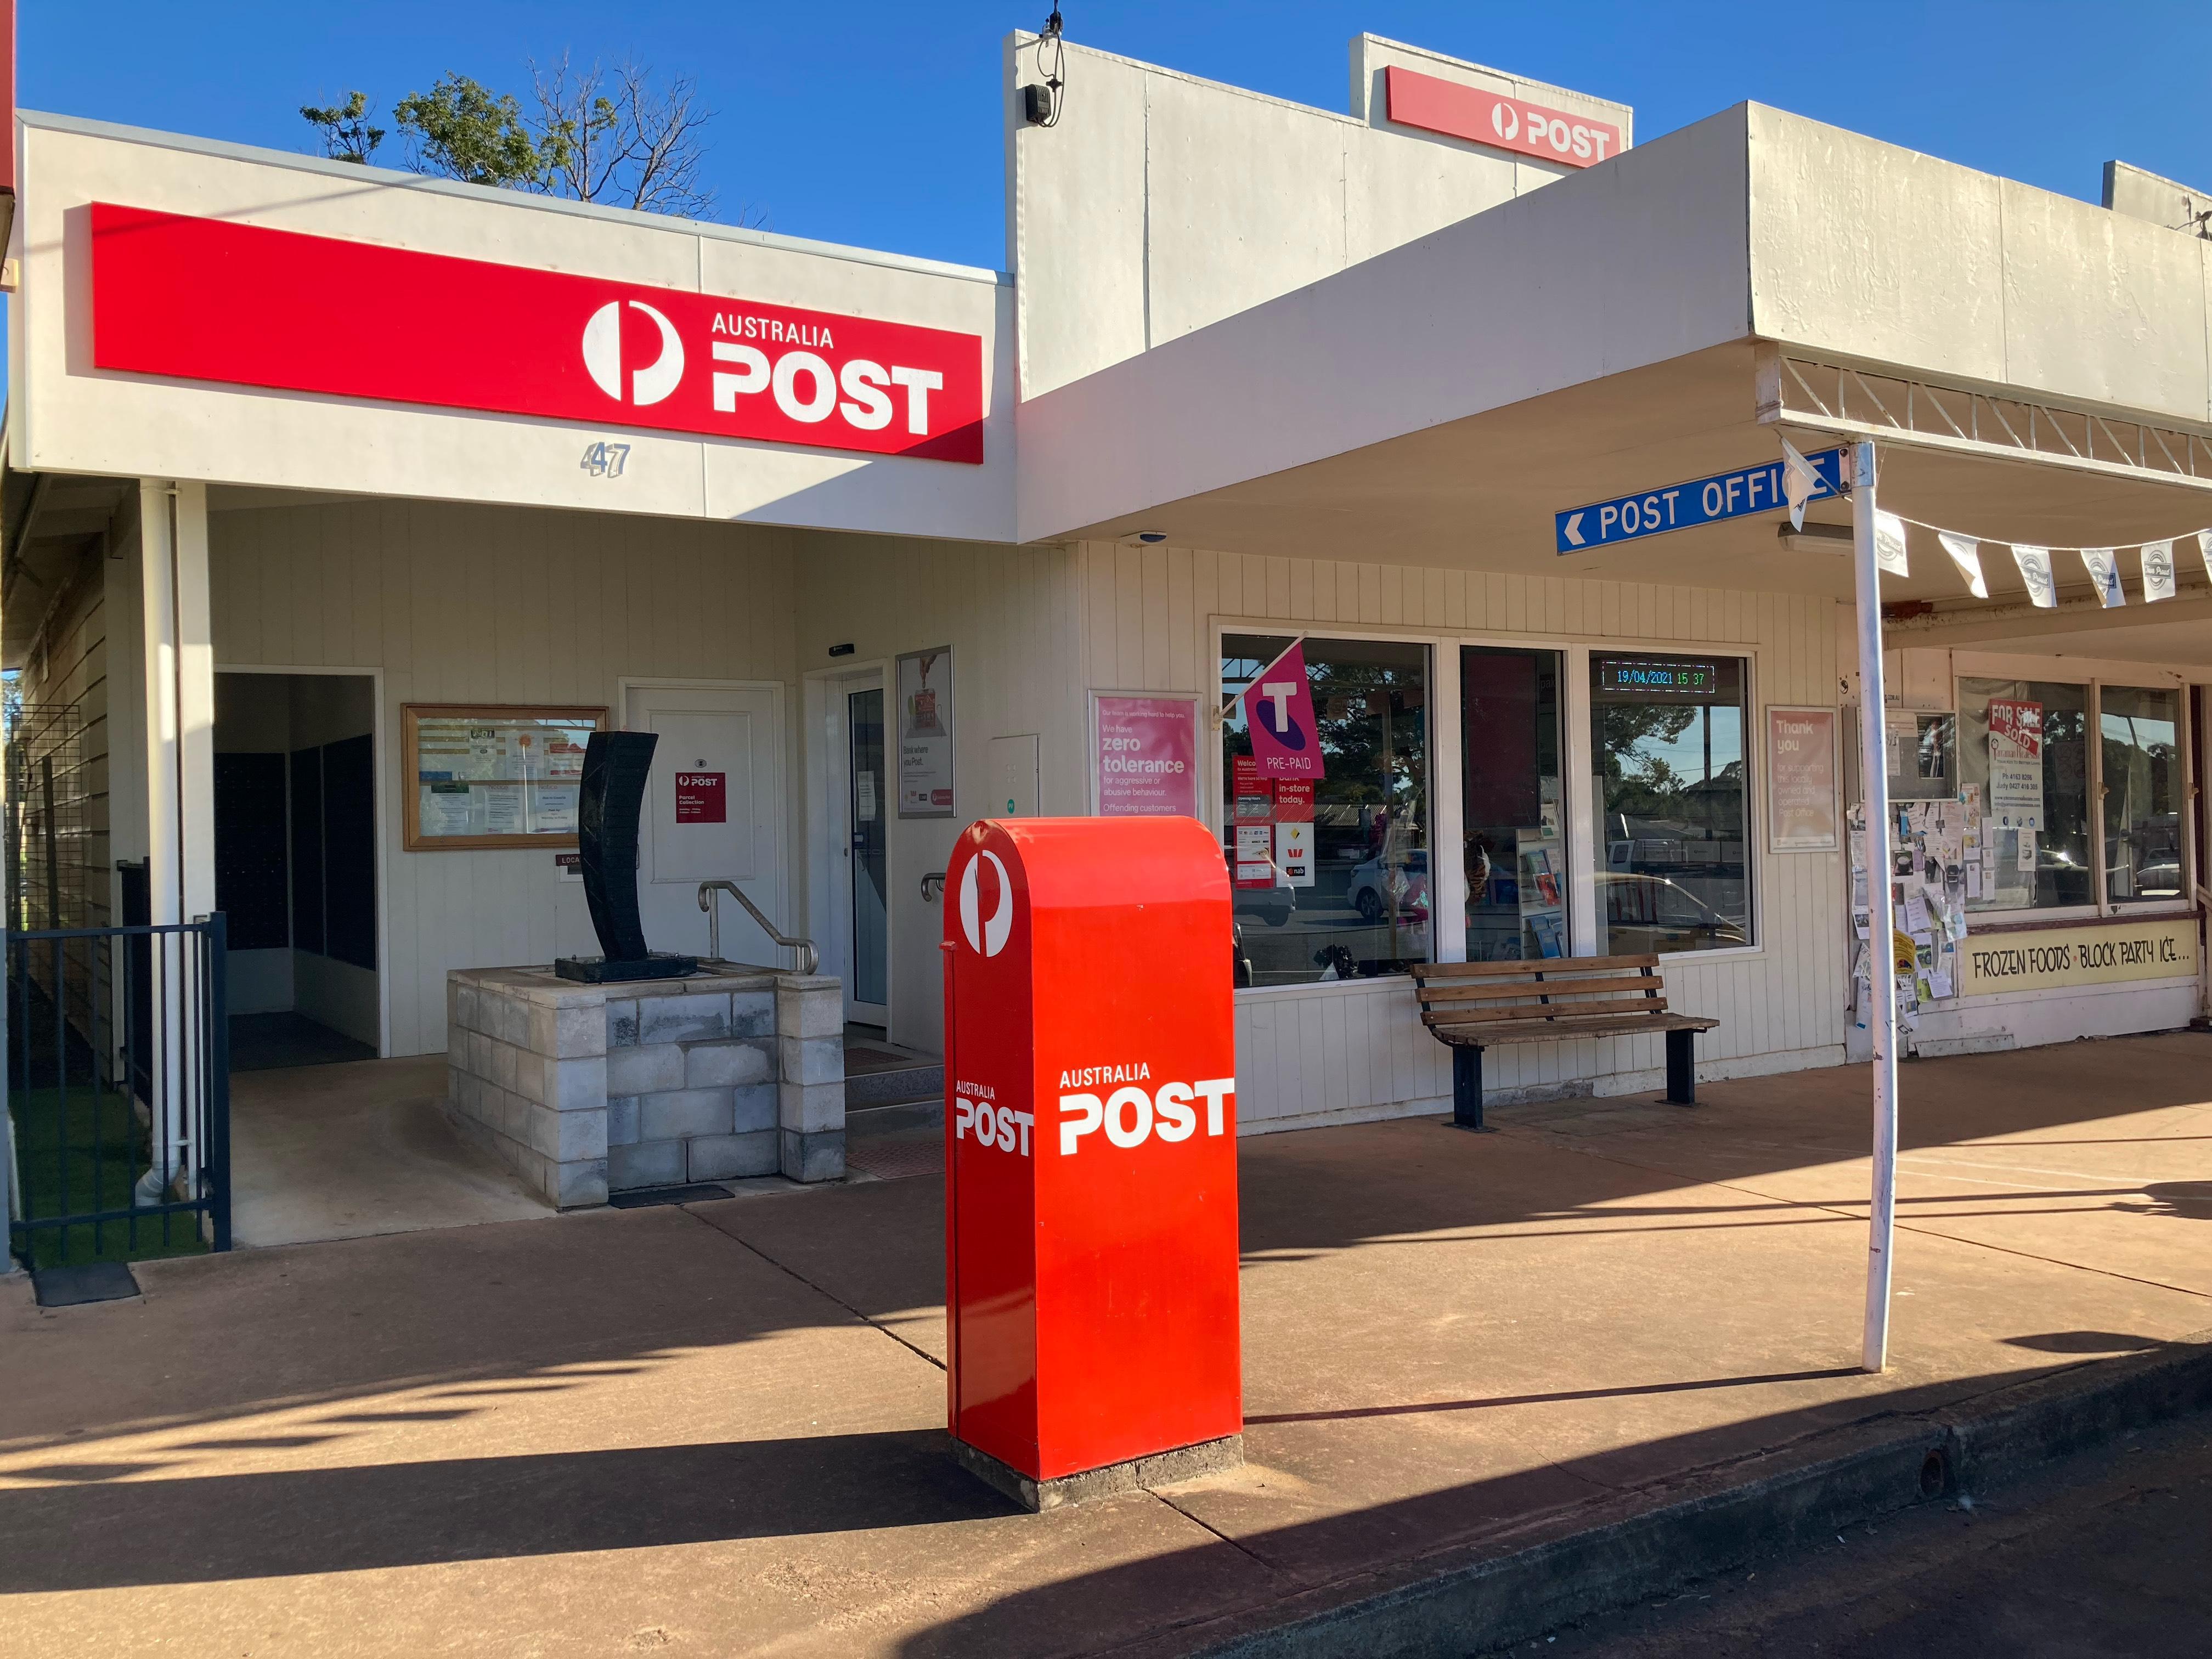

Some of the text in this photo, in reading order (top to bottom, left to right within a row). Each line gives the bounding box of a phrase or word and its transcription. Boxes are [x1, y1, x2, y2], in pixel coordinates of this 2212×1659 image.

[1527, 112, 1609, 161] POST
[712, 312, 834, 349] AUSTRALIA
[712, 341, 943, 435] POST
[591, 442, 630, 475] 47
[1600, 458, 1827, 539] POST OFFI
[2155, 566, 2170, 575] Proud
[2032, 572, 2048, 585] Proud
[2097, 574, 2114, 585] Proud
[1617, 669, 1705, 685] 19/04/2021 15 37
[1262, 681, 1297, 732] T
[1992, 704, 2013, 725] FOR
[1116, 724, 1132, 733] have
[1776, 719, 1813, 734] Thank
[2004, 724, 2030, 749] SOLD
[903, 745, 928, 754] Bank where
[1102, 737, 1141, 751] zero
[1777, 740, 1799, 754] you
[912, 757, 924, 766] Post.
[1103, 755, 1185, 774] tolerance
[1267, 757, 1312, 769] PRE-PAID
[1777, 763, 1824, 774] for supporting
[691, 778, 718, 786] POST
[1115, 777, 1152, 786] aggressive
[1778, 775, 1812, 785] this locally
[1132, 788, 1167, 796] behaviour.
[1778, 786, 1815, 795] owned and
[1279, 795, 1305, 805] today.
[1778, 798, 1809, 807] operated
[1103, 803, 1139, 813] Offending
[1779, 808, 1815, 817] Post Office
[1972, 949, 2026, 979] FROZEN
[2028, 943, 2070, 974] FOODS
[2078, 941, 2117, 969] BLOCK
[2118, 939, 2154, 966] PARTY
[1059, 1062, 1150, 1089] AUSTRALIA
[956, 1080, 995, 1100] AUSTRALIA
[1059, 1077, 1235, 1156] POST
[956, 1097, 1034, 1156] POST
